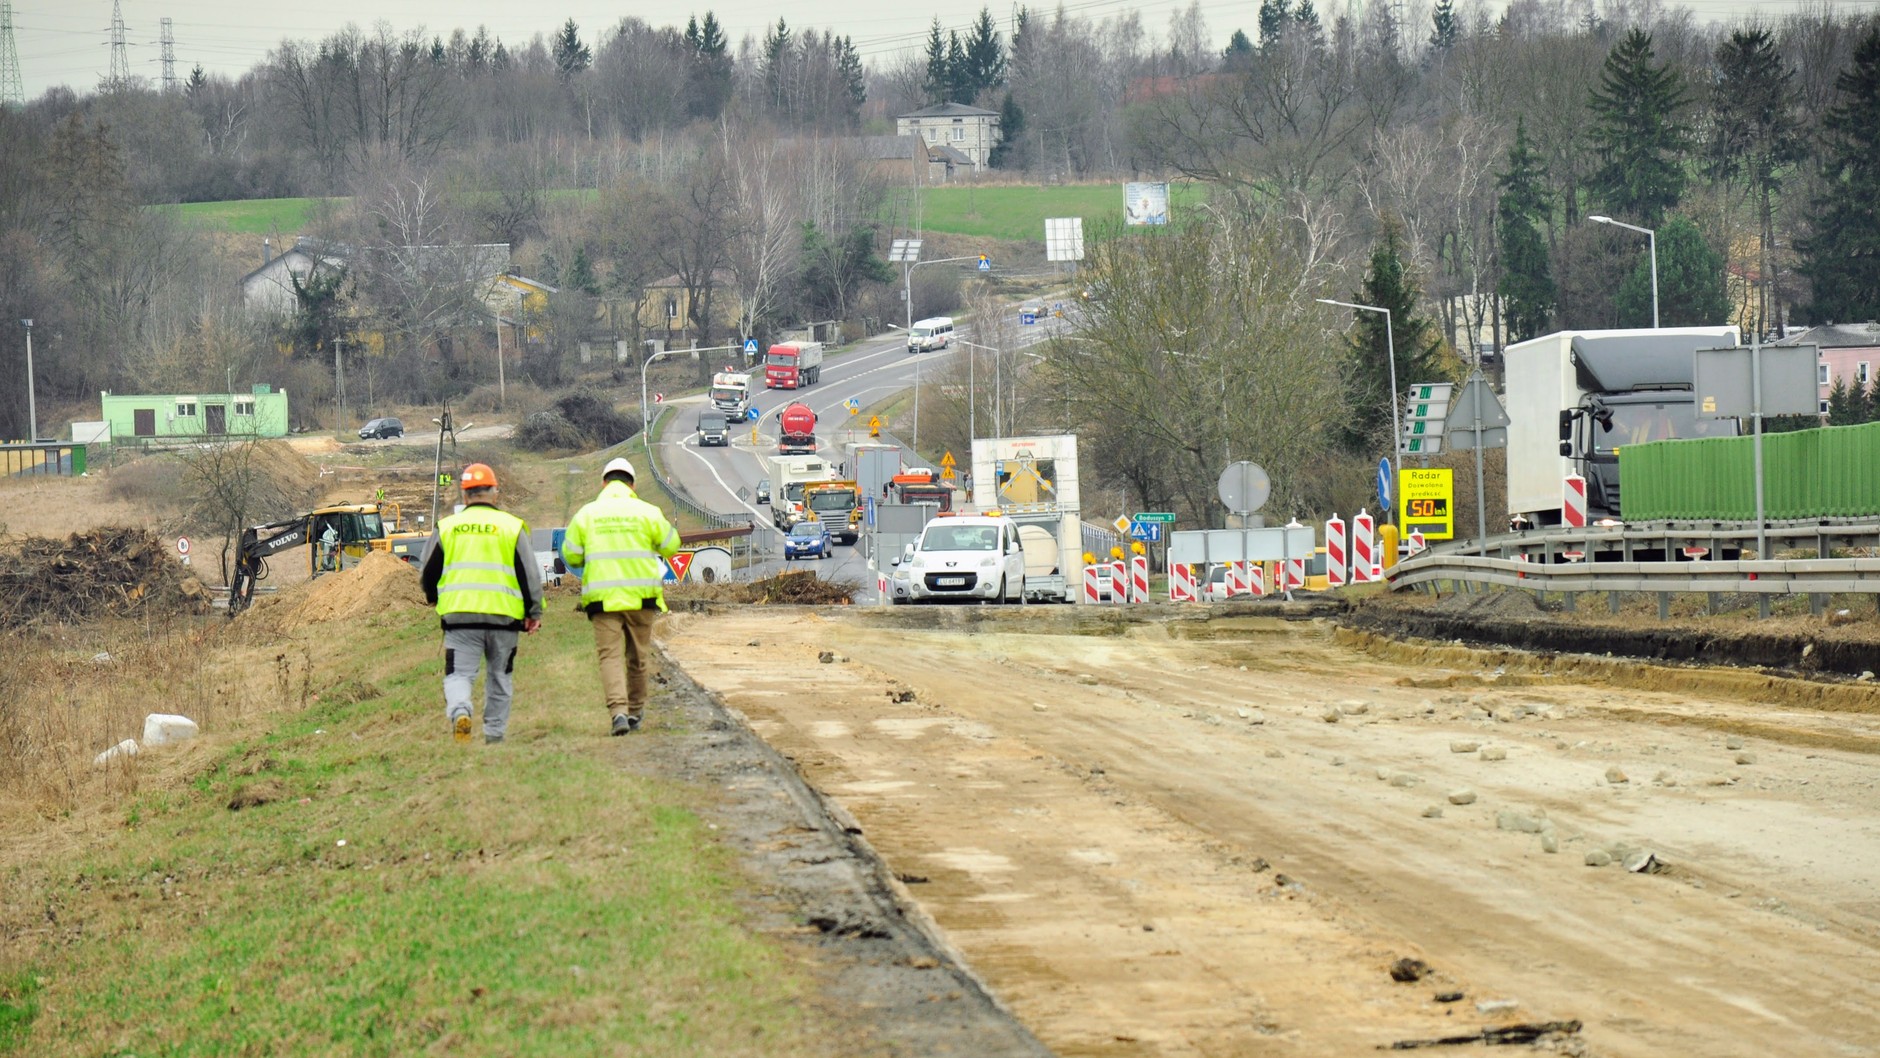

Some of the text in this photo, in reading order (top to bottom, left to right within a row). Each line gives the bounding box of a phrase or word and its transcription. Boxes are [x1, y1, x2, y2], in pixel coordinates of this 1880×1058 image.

[1411, 472, 1441, 480] Radar
[1411, 500, 1434, 516] 50
[268, 532, 298, 549] VOLVO
